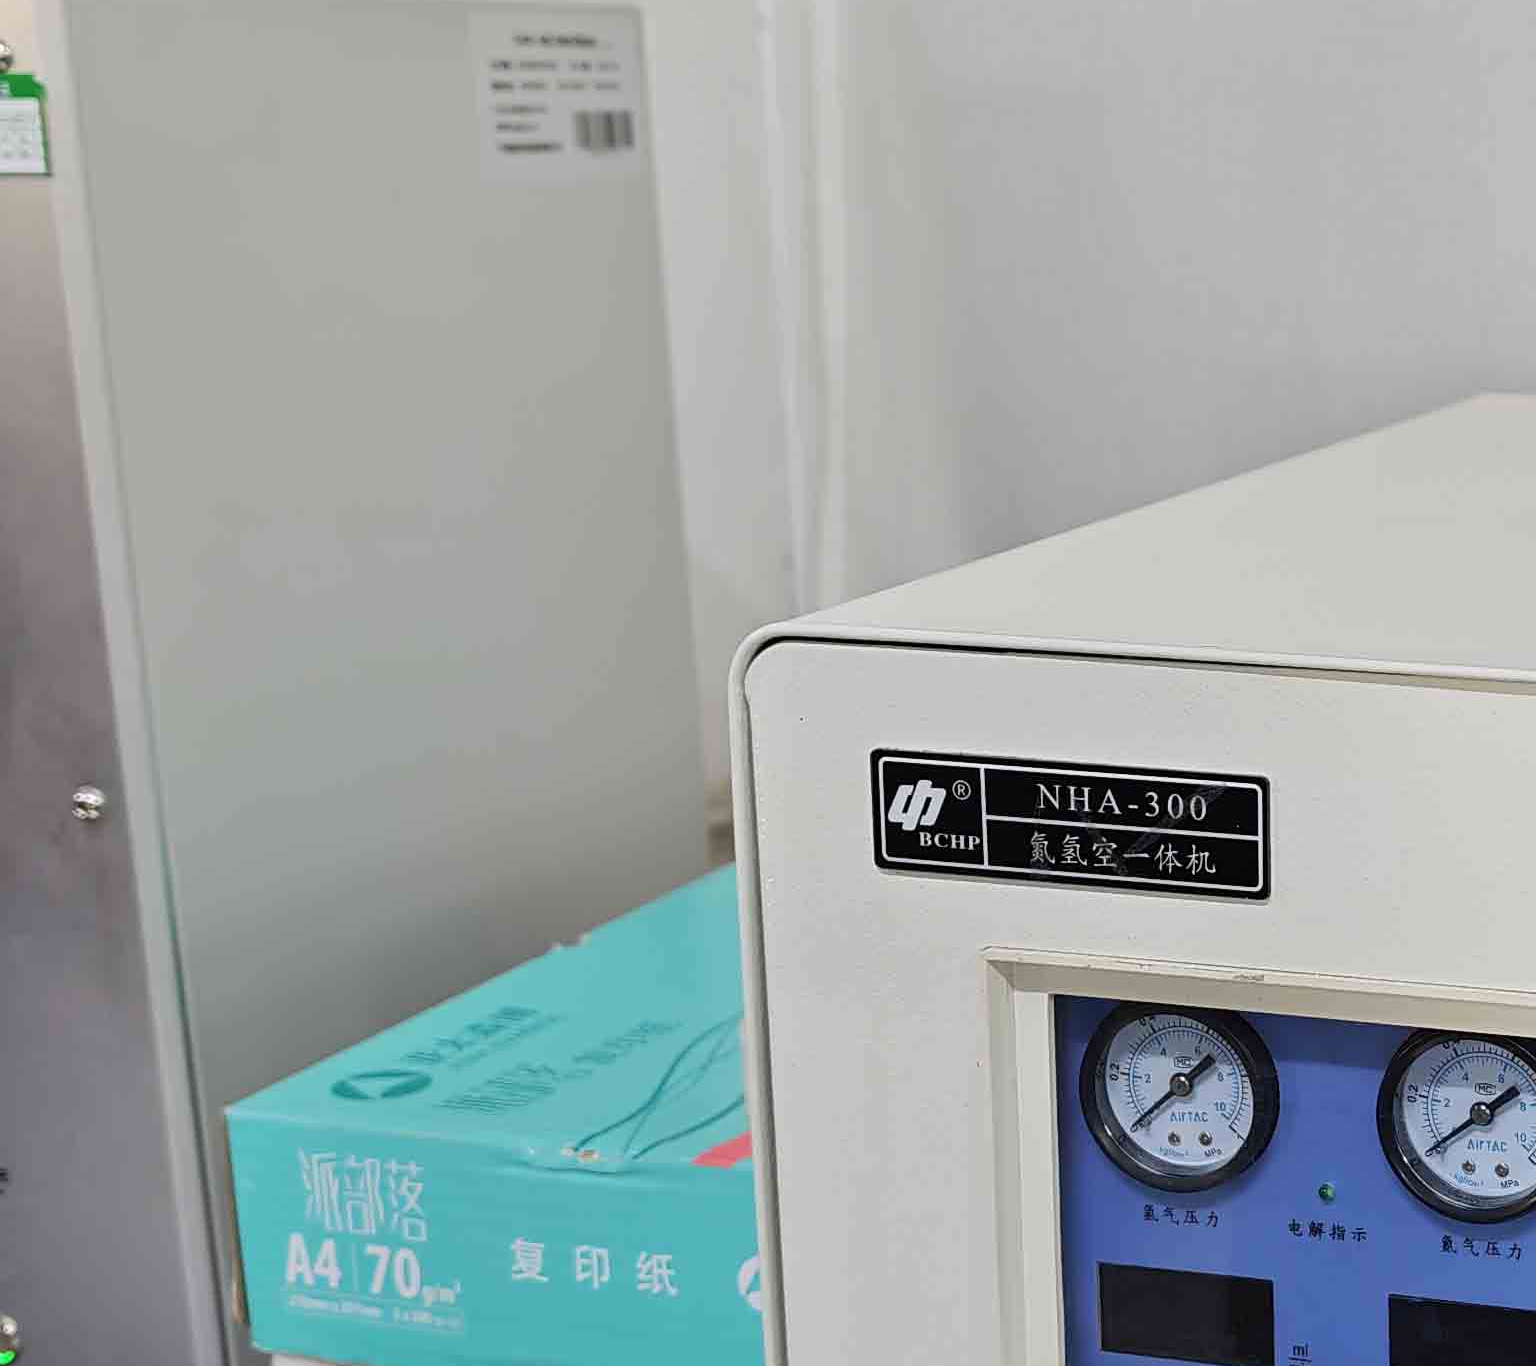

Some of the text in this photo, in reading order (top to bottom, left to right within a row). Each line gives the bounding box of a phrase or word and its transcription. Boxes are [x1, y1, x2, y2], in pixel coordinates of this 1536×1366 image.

[1036, 783, 1207, 822] NHA-300
[919, 831, 980, 851] BCHP
[1030, 831, 1217, 875] 氮氢空一体机
[1288, 1219, 1368, 1243] 电解指示
[286, 1232, 342, 1288] A4
[365, 1245, 421, 1298] 70
[510, 1237, 679, 1296] 复印纸
